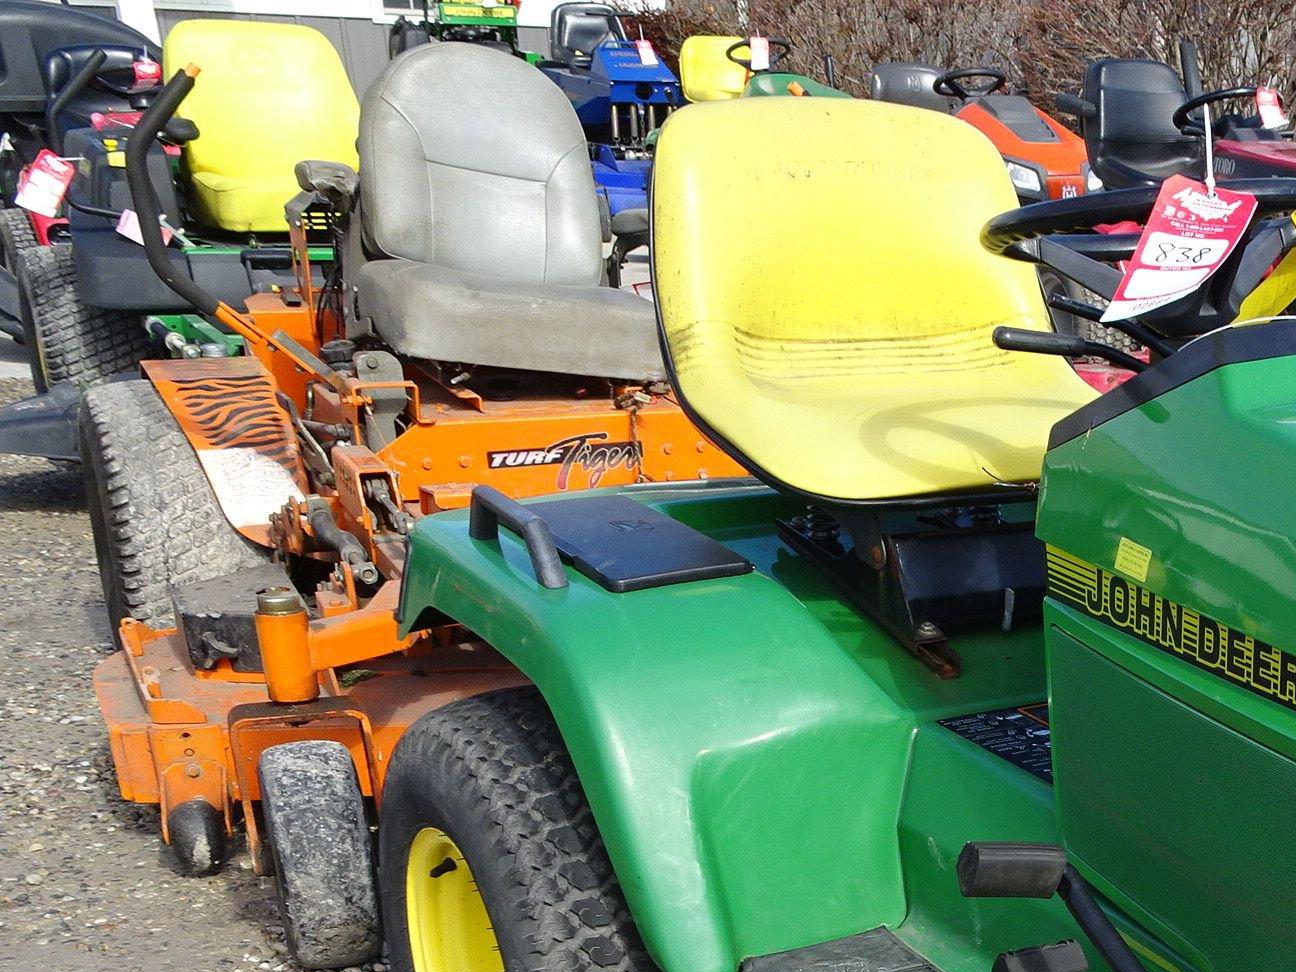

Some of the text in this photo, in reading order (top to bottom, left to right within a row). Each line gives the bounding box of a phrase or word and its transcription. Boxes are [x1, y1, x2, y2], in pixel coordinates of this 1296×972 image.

[1213, 157, 1236, 176] TORO
[1155, 242, 1212, 264] 838
[490, 431, 643, 491] TURF Tiger
[1086, 567, 1185, 654] JOHN
